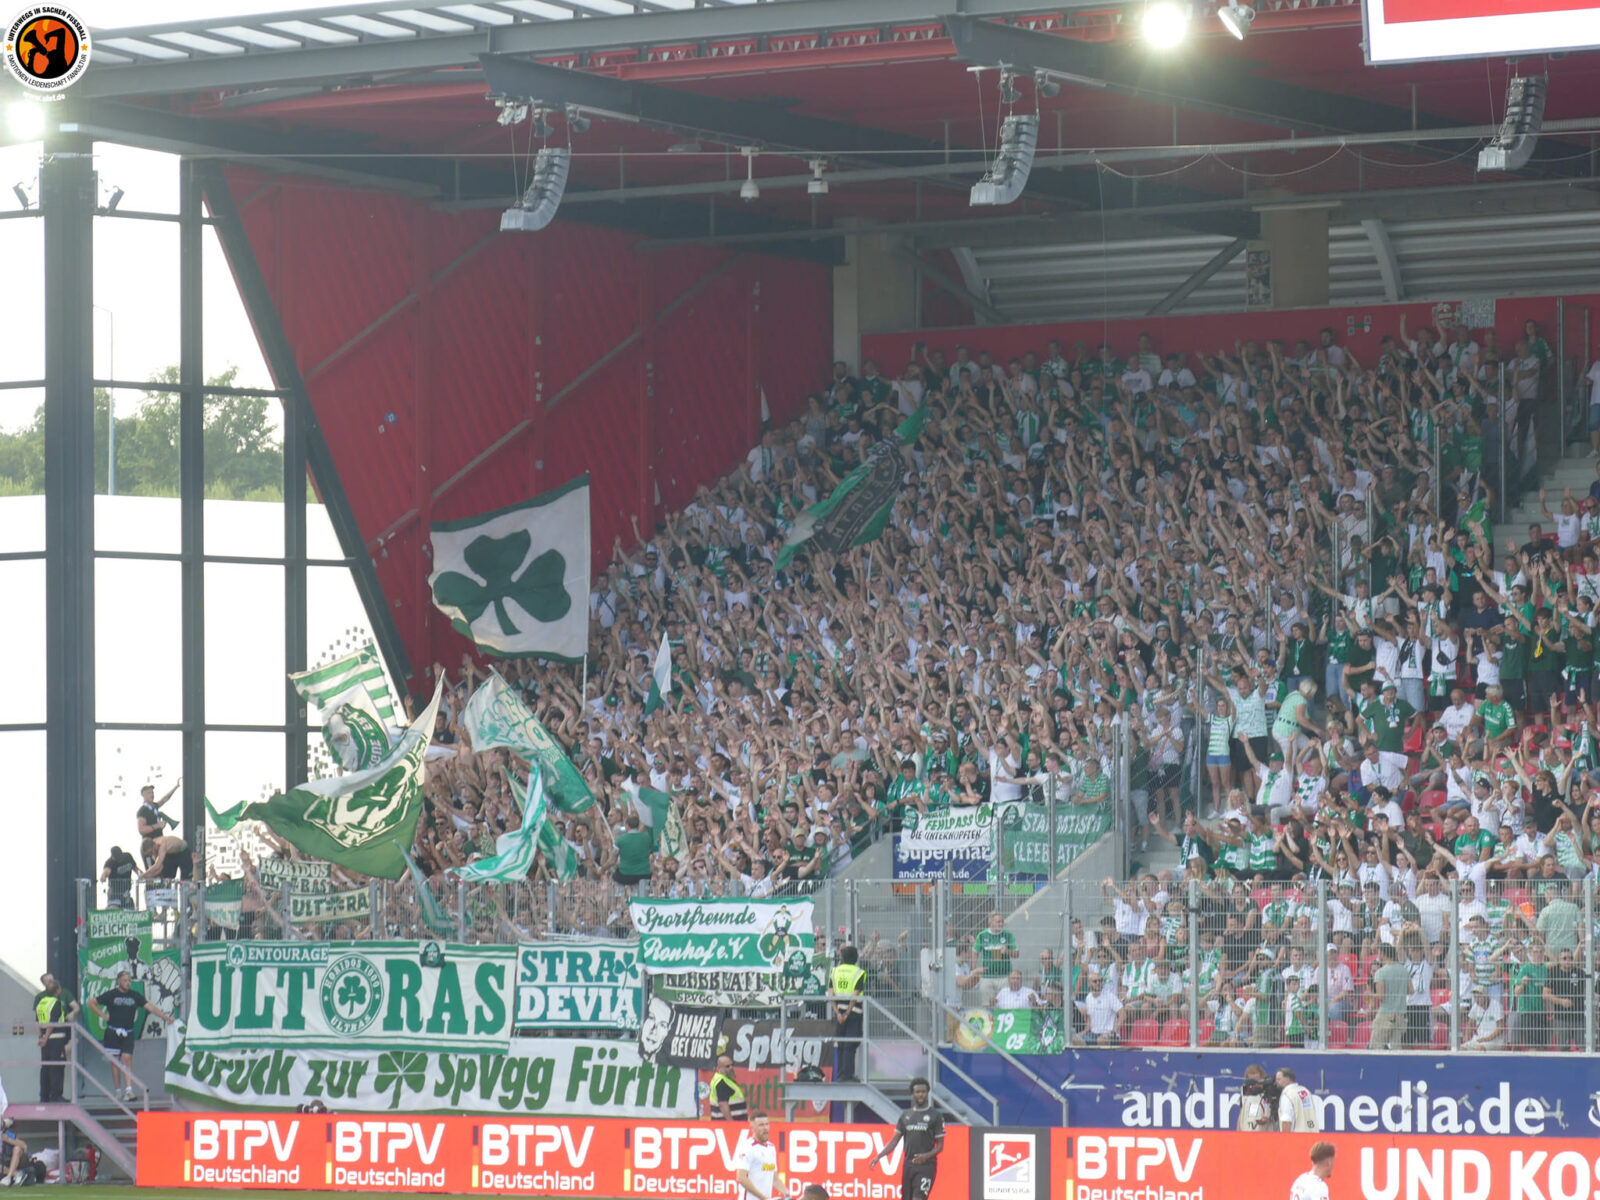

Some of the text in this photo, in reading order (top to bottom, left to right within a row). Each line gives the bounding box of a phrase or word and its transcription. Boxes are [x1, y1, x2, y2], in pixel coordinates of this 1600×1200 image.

[93, 923, 128, 936] PFLICHT
[637, 904, 757, 932] Sportfreunde
[248, 947, 328, 962] ENTOURAGE
[521, 950, 619, 983] STRA
[517, 986, 637, 1022] DEVIA
[330, 1013, 372, 1033] ULTRAS
[675, 1013, 717, 1038] IMMER
[996, 1012, 1015, 1034] 19
[670, 1036, 691, 1057] BEI
[303, 1060, 369, 1098] zur
[433, 1053, 555, 1111] SpVgg
[566, 1046, 682, 1108] Fürth
[193, 1120, 300, 1162] BTPV
[335, 1122, 445, 1165] BTPV
[482, 1124, 595, 1168] BTPV
[634, 1126, 750, 1171] BTPV
[789, 1130, 905, 1176] BTPV
[1077, 1135, 1203, 1183] BTPV
[193, 1164, 300, 1184] Deutschland
[335, 1167, 445, 1188] Deutschland
[482, 1169, 595, 1191] Deutschland
[1360, 1147, 1600, 1200] UND KO
[1077, 1185, 1203, 1200] Deutschland
